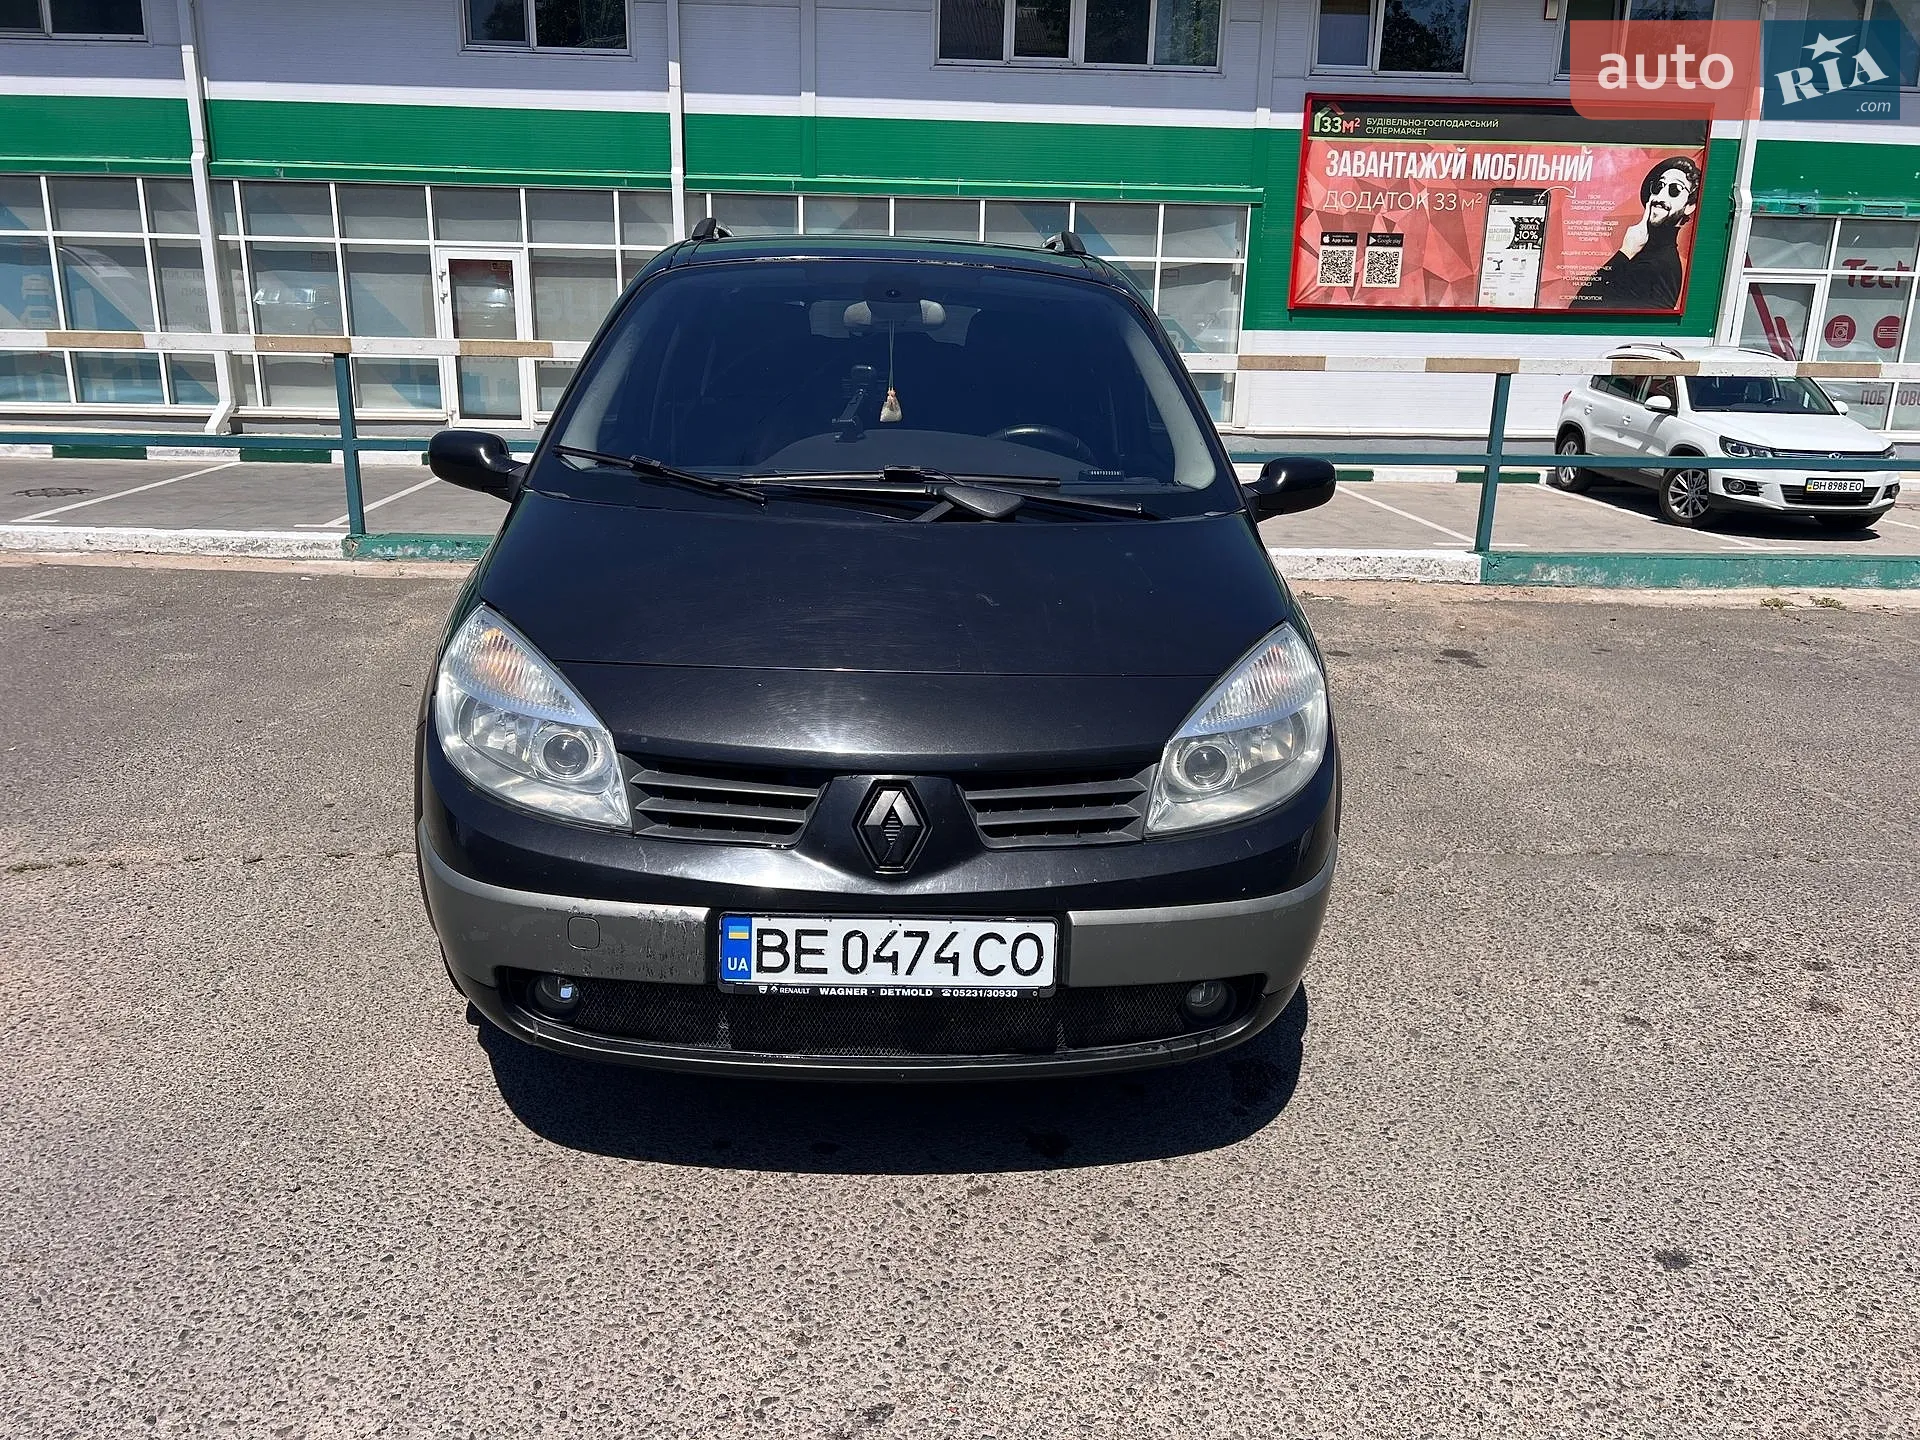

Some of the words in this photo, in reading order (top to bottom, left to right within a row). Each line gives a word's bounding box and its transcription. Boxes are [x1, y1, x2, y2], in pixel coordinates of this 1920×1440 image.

[1366, 117, 1500, 129] БУДІВЕЛЬНО-ГОСПОДАРСЬКИЙ
[1365, 127, 1428, 136] СУПЕРМАРКЕТ
[1325, 147, 1467, 180] ЗАВАНТАЖУЙ
[1471, 146, 1594, 183] МОБІЛЬНИЙ
[1323, 190, 1431, 213] ДОДАТОК
[1433, 193, 1458, 212] 33
[1812, 481, 1827, 491] BH
[755, 928, 829, 975] BE
[841, 929, 960, 977] 0474
[972, 931, 1045, 977] CO
[727, 957, 749, 971] UA
[779, 987, 811, 995] RENAULT
[819, 987, 869, 996] WAGNER
[879, 987, 934, 997] DETMOLD
[952, 988, 1019, 998] 05231/30930
